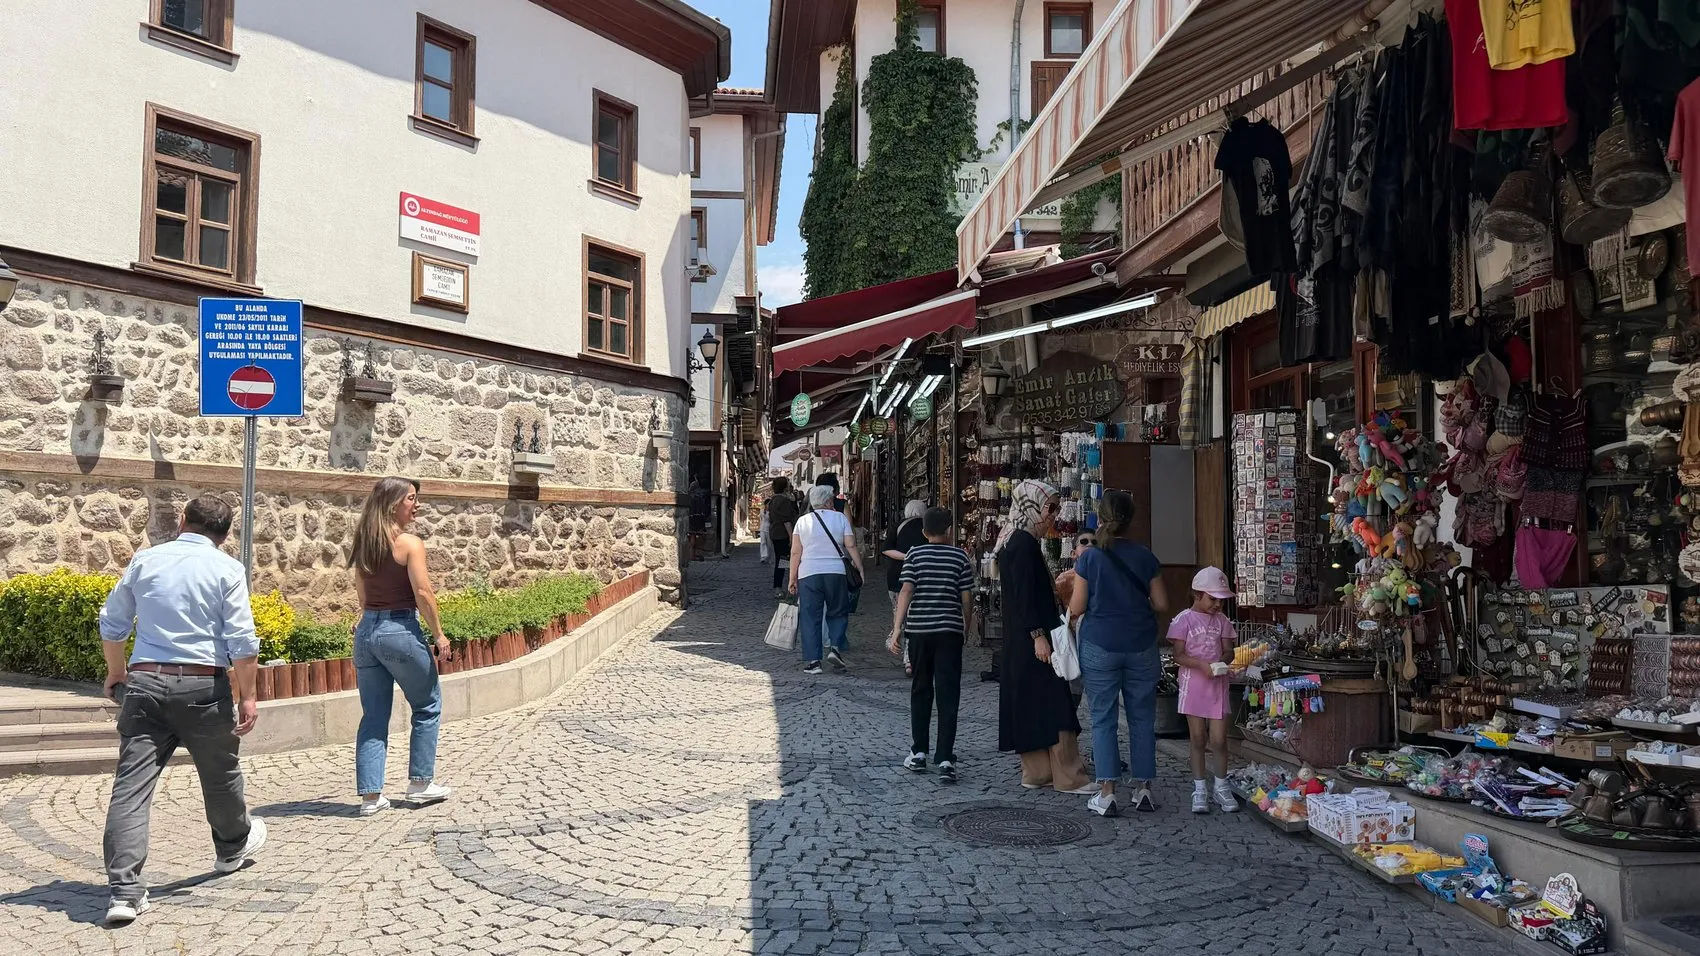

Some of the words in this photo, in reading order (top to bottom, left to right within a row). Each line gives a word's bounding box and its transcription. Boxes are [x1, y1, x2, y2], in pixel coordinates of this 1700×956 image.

[420, 226, 448, 237] RAMAZAN
[238, 314, 268, 322] 23/05/2011
[205, 332, 225, 340] GEREĞİ
[272, 333, 298, 341] SAATLERİ
[248, 352, 294, 360] YAPILMAKTADIR.
[1014, 376, 1053, 394] Emir
[1064, 364, 1114, 386] Antik
[1016, 391, 1062, 412] Sanat
[1022, 412, 1052, 425] 0535
[1054, 407, 1077, 422] 342
[1078, 404, 1093, 418] 97
